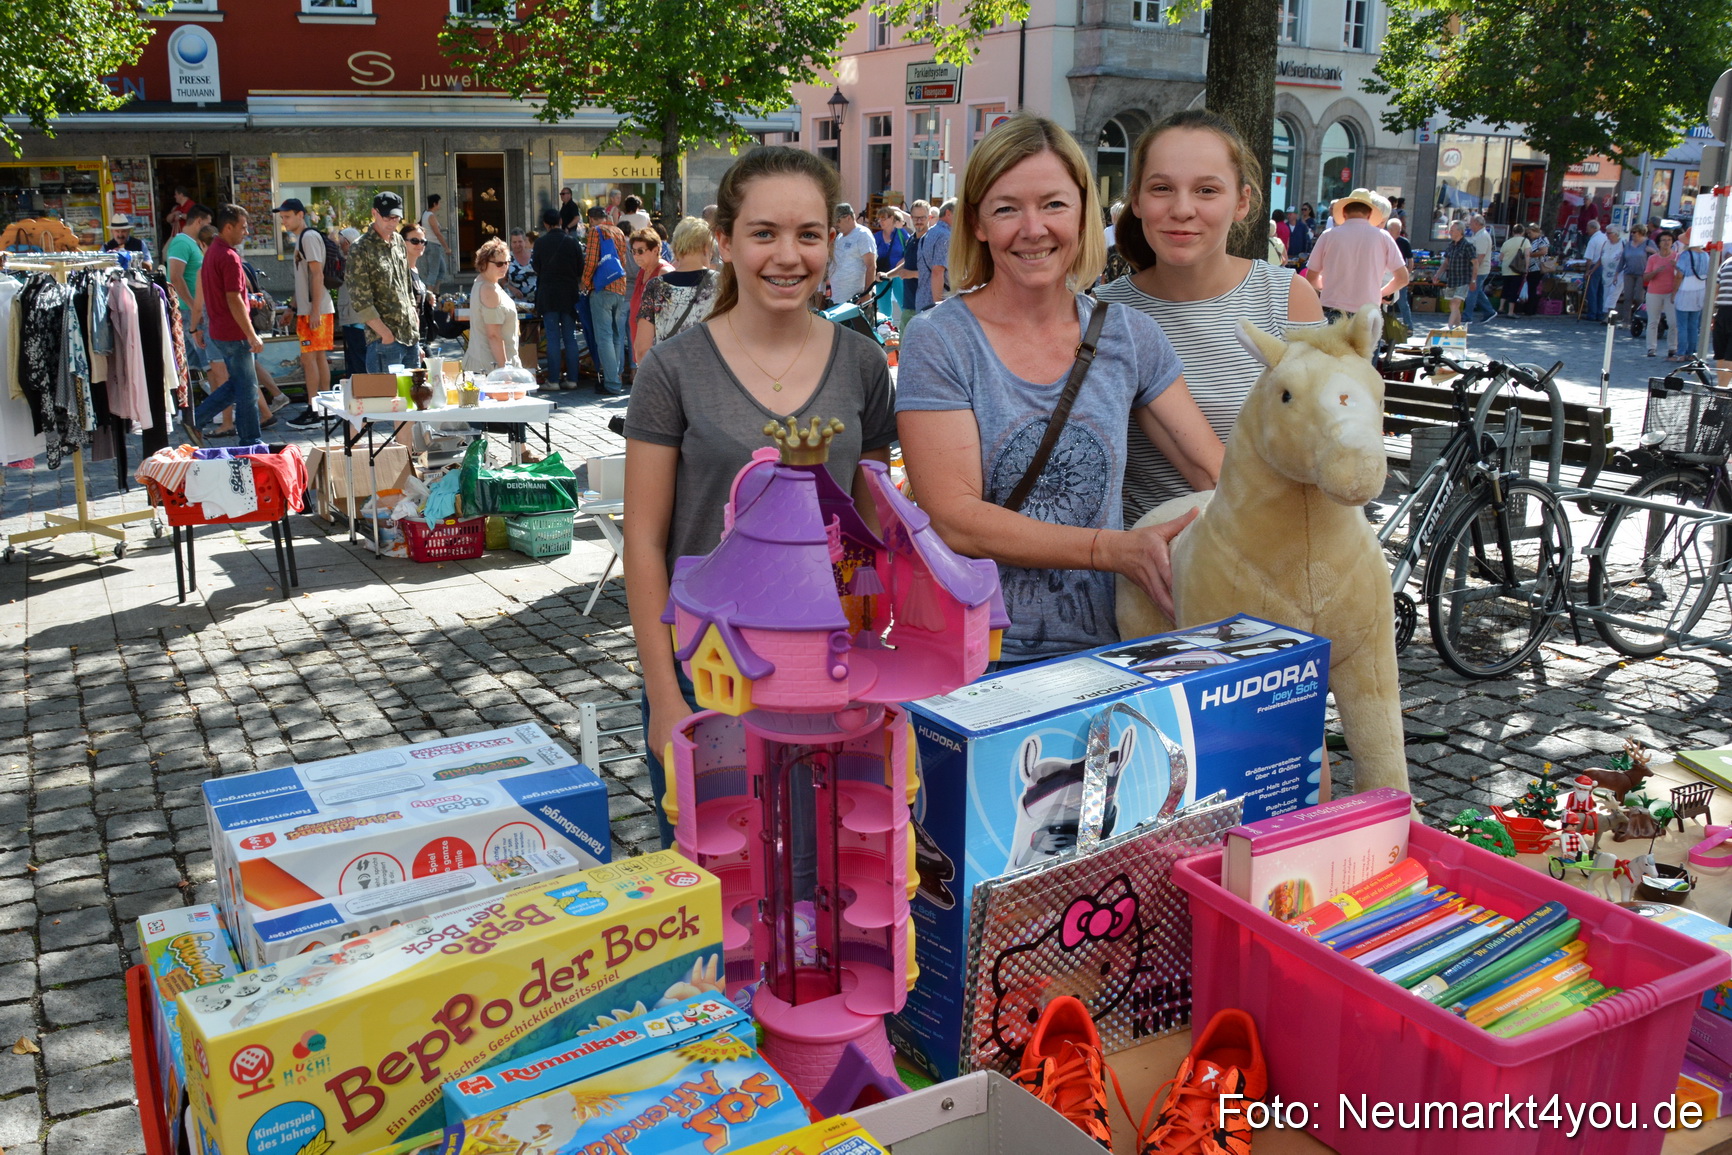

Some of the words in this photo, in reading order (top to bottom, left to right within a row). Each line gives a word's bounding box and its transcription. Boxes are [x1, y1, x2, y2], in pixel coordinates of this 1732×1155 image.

[180, 76, 212, 84] PRESSE
[914, 67, 948, 80] Parkleitsystem
[176, 88, 215, 98] THUMANN
[334, 168, 412, 180] SCHLIERF
[612, 167, 662, 177] SCHLIE
[506, 482, 546, 490] DEICHMANN
[1422, 480, 1454, 545] Kalkhoff
[1075, 680, 1144, 700] HUDORA
[1200, 660, 1318, 710] HUDORA
[1272, 688, 1292, 704] joey
[1296, 681, 1318, 695] Soft
[1256, 692, 1318, 714] Freizeitschlittschuh
[918, 724, 962, 752] HUDORA
[1244, 756, 1302, 776] Größenverstellbar
[1254, 772, 1270, 780] über
[1278, 763, 1302, 774] Größen
[216, 784, 298, 803] Ravensburger
[522, 780, 600, 801] Ravensburger
[1244, 788, 1265, 797] Fester
[1266, 782, 1280, 791] Halt
[1282, 776, 1300, 786] durch
[1258, 784, 1300, 800] Power-Strap
[410, 794, 463, 808] family
[437, 796, 490, 814] tiptoi
[1266, 798, 1298, 812] Push-Lock
[1271, 805, 1298, 817] Schnalle
[228, 808, 312, 828] Ravensburger
[284, 810, 404, 841] Deutschland
[539, 804, 606, 856] Ravensburger
[428, 852, 438, 873] Spiel
[442, 840, 452, 866] ganze
[455, 849, 464, 869] milie
[562, 888, 580, 897] 2007
[1358, 894, 1370, 903] Conni
[193, 912, 211, 922] MB
[466, 903, 508, 928] der
[572, 902, 606, 915] Kinderspiel
[268, 918, 338, 940] Ravensburger
[440, 904, 557, 955] Beppo
[1485, 937, 1506, 950] Olchis
[1524, 916, 1538, 926] zum
[1534, 906, 1553, 918] Mond
[401, 924, 470, 955] Bock
[1494, 986, 1543, 1012] Hexengeschichten
[324, 992, 513, 1134] Beppo
[518, 957, 594, 1008] der
[600, 904, 700, 970] Bock
[1132, 1004, 1192, 1040] KITT
[1505, 1022, 1514, 1032] den
[1514, 1016, 1532, 1028] Spuren
[386, 1112, 407, 1136] Ein
[408, 1050, 487, 1118] magnetisches
[490, 970, 620, 1052] Geschicklichkeitsspiel
[498, 1028, 638, 1084] Rummikub
[283, 1056, 332, 1081] HUCH!
[578, 1070, 724, 1155] Affenala
[254, 1109, 316, 1140] Kinderspiel
[258, 1140, 278, 1152] des
[280, 1124, 317, 1145] Jahres
